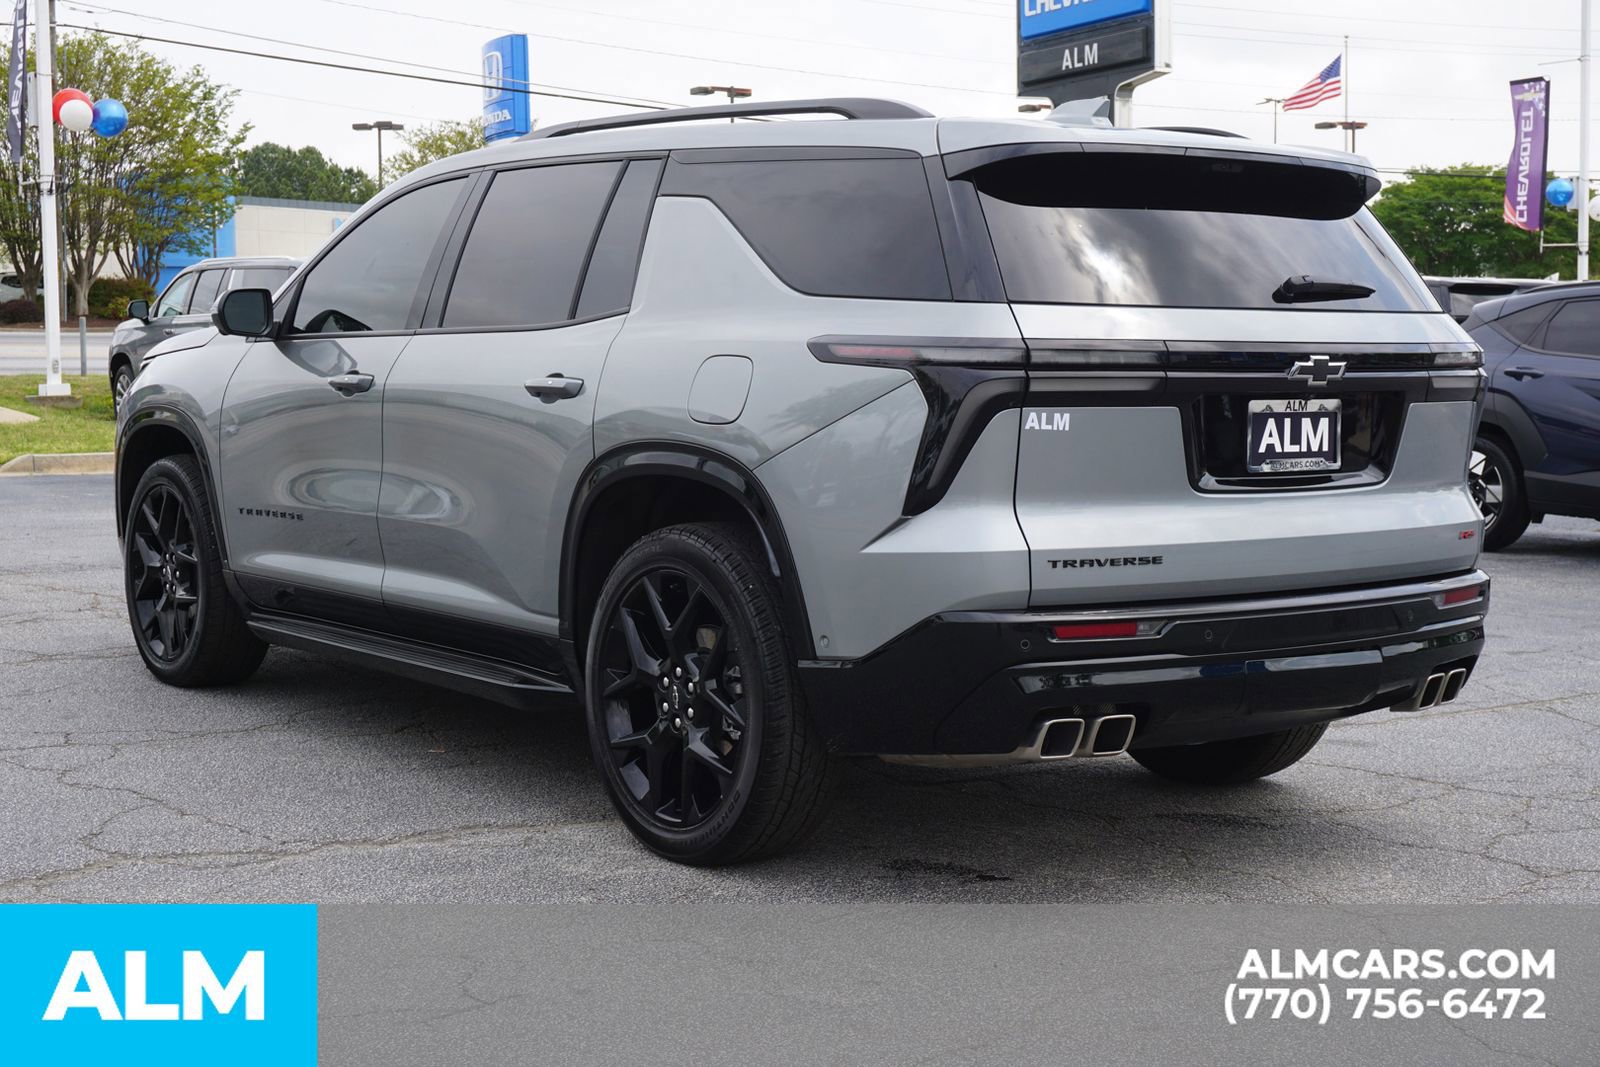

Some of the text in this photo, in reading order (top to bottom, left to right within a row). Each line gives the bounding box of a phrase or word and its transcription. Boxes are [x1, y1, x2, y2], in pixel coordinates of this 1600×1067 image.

[1062, 42, 1098, 71] ALM
[1284, 400, 1308, 411] ALM
[1024, 411, 1071, 431] ALM
[1258, 417, 1329, 453] ALM
[238, 507, 304, 521] TRAVERSE
[1047, 555, 1164, 569] TRAVERSE
